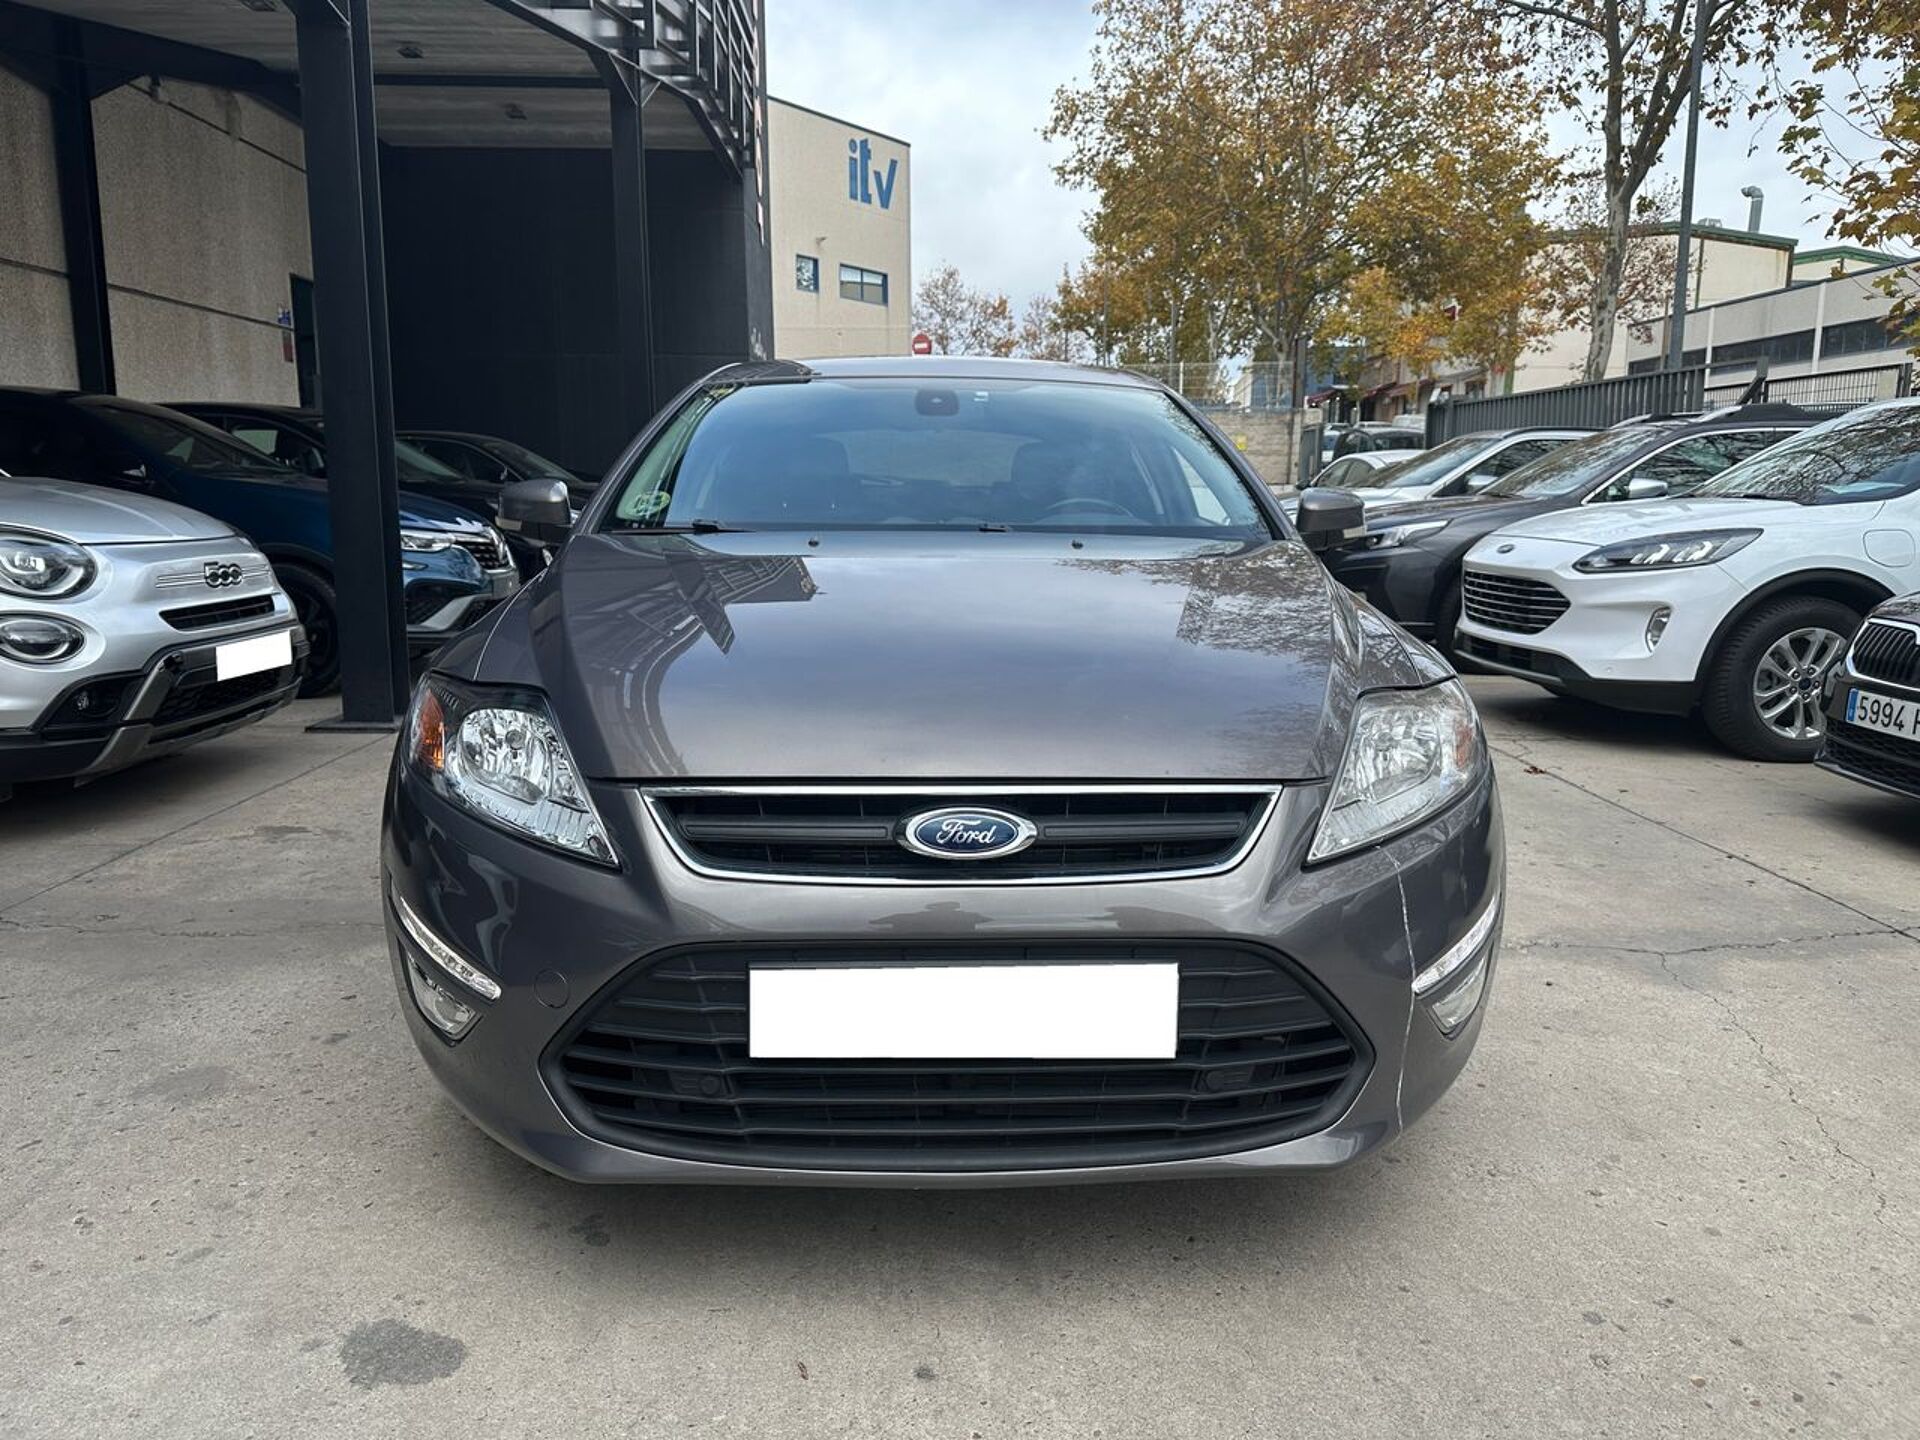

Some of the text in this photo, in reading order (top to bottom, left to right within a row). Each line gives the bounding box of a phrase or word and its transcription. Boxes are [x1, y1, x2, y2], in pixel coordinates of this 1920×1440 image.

[848, 138, 898, 210] itv
[204, 561, 242, 588] 500
[1858, 696, 1905, 731] 5994
[936, 819, 996, 844] Ford
